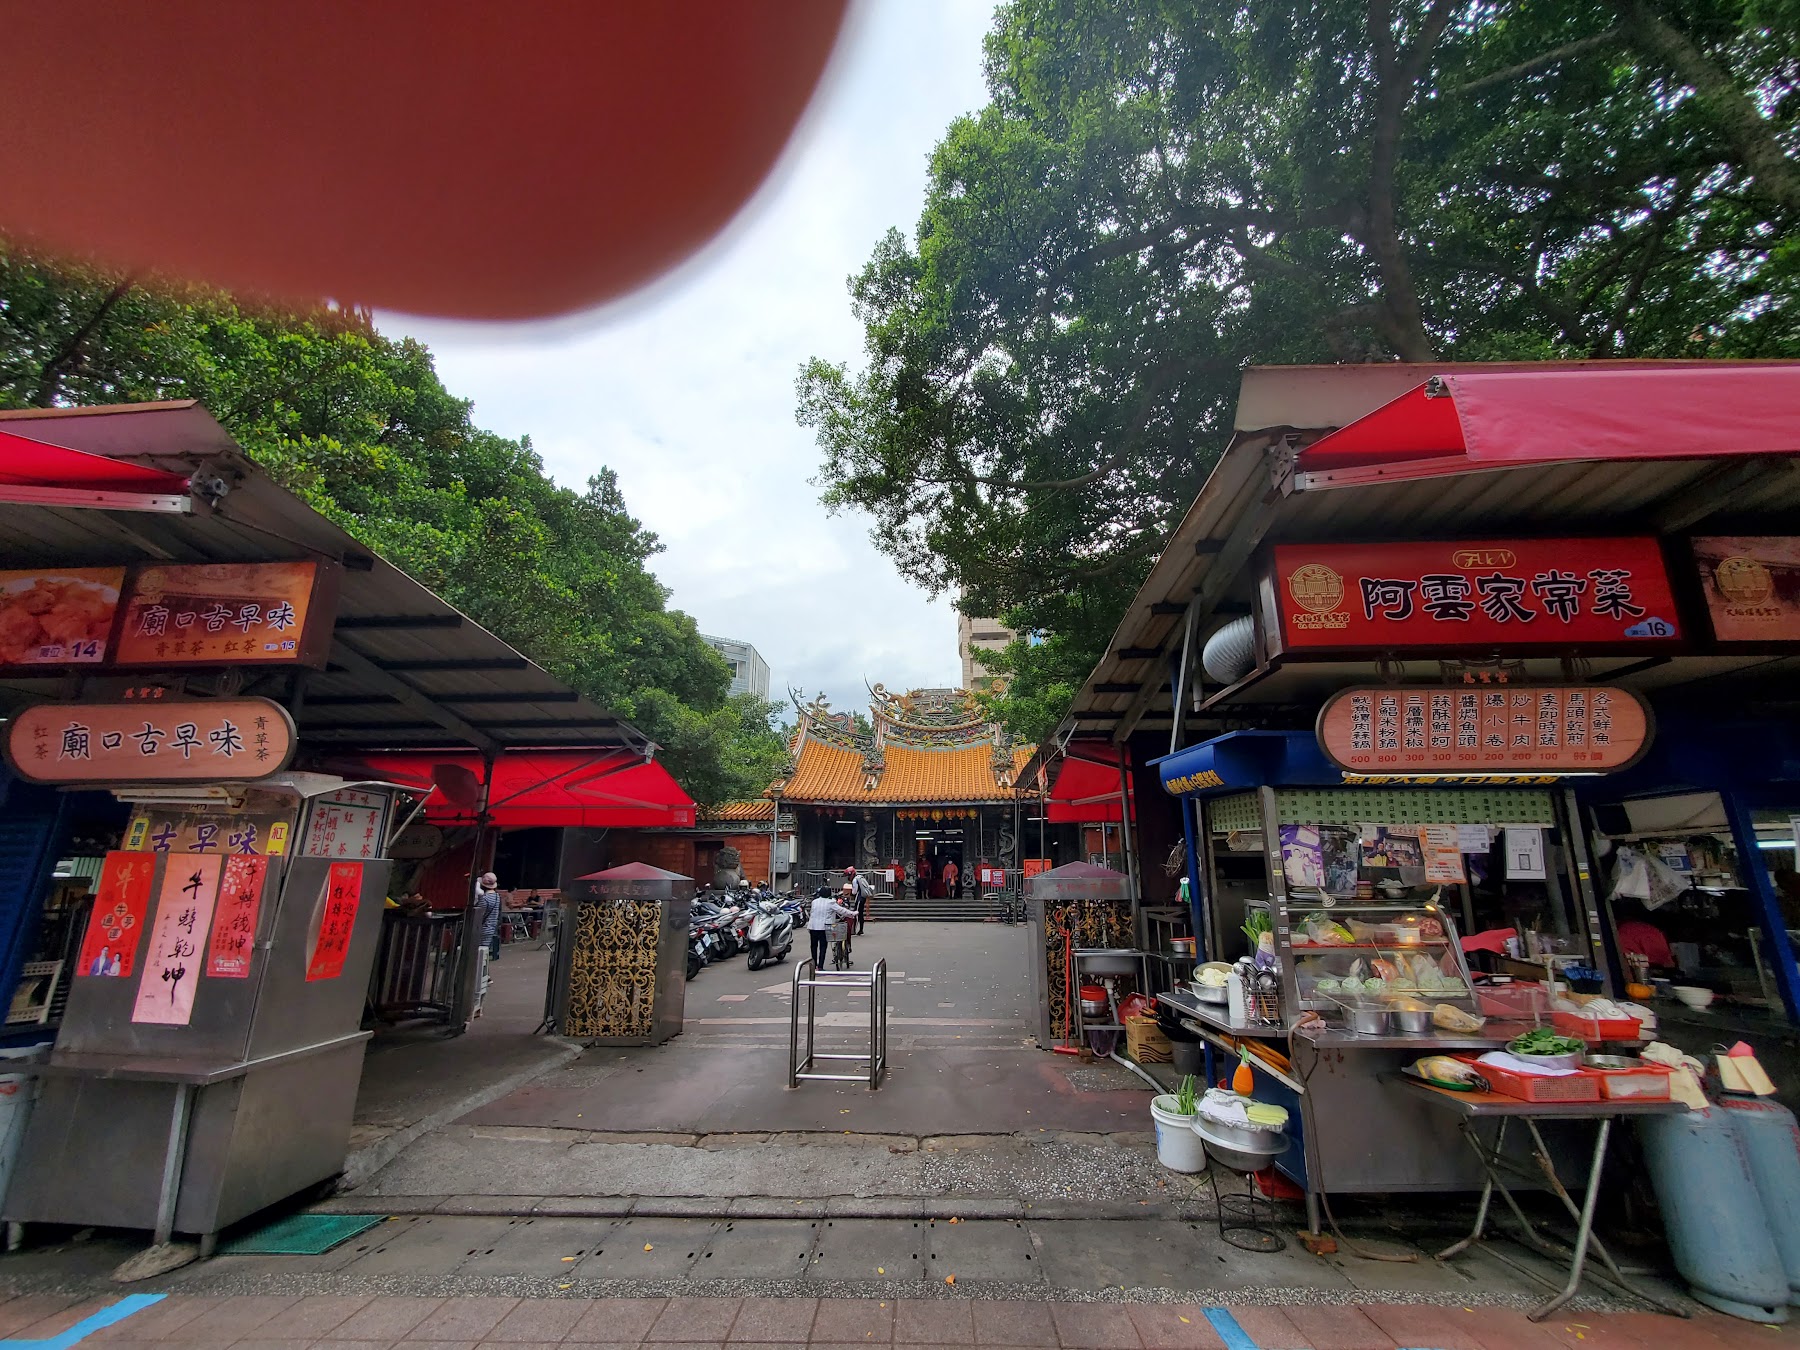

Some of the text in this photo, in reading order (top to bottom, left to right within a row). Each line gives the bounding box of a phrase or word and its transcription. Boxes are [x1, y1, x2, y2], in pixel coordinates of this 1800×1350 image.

[1359, 569, 1645, 623] 阿雲家常菜
[135, 601, 297, 637] 廟口古早味
[1649, 621, 1667, 636] 16
[72, 641, 97, 657] 14
[281, 641, 295, 650] 15
[1378, 695, 1398, 749] 白鯧米粉鍋
[1431, 695, 1451, 747] 蒜酥鮮蚵
[1485, 693, 1505, 746] 爆小卷
[1512, 693, 1531, 746] 炒牛肉
[1539, 693, 1558, 746] 季節時蔬
[1592, 692, 1612, 745] 各式鮮魚
[58, 719, 247, 760] 廟口古早味
[254, 715, 270, 762] 青草茶
[1539, 752, 1558, 760] 100
[1351, 755, 1370, 763] 500
[1378, 754, 1397, 762] 800
[1432, 753, 1451, 761] 300
[1458, 753, 1477, 761] 500
[334, 791, 370, 805] 古早味
[129, 822, 146, 851] 青草
[152, 821, 260, 855] 古早味
[359, 810, 379, 858] 青草茶
